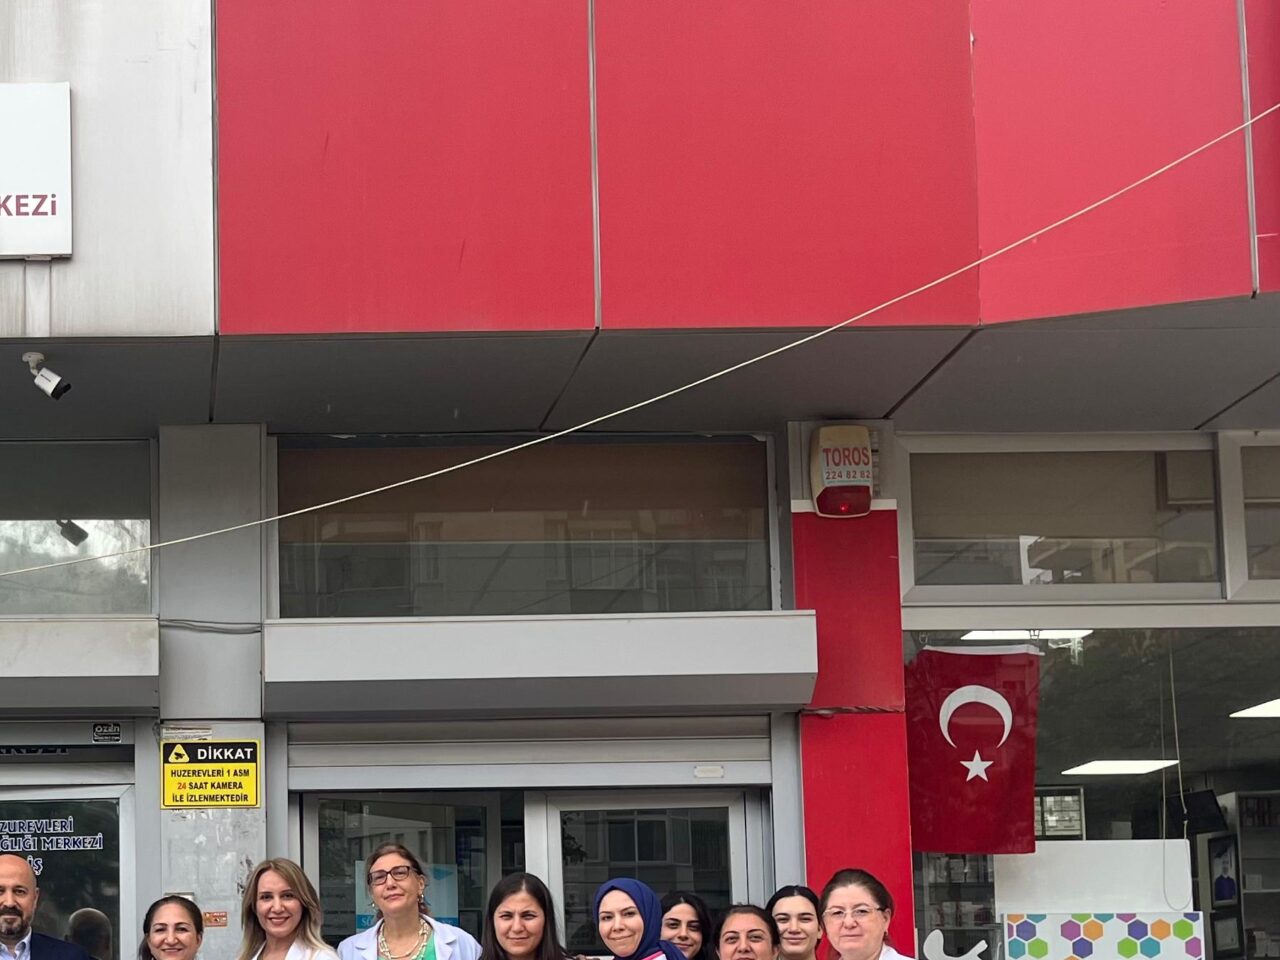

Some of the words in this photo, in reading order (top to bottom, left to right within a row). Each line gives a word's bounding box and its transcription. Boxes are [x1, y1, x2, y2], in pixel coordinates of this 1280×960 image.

[822, 447, 870, 467] TOROS
[825, 470, 843, 480] 224
[197, 745, 254, 760] DİKKAT
[170, 768, 224, 777] HUZEREVLERİ
[226, 769, 231, 777] 1
[232, 769, 250, 777] ASM
[177, 782, 187, 790] 24
[188, 782, 208, 790] SAAT
[210, 782, 243, 790] KAMERA
[172, 793, 184, 802] İLE
[186, 793, 249, 802] İZLENMEKTEDİR
[41, 832, 104, 850] MERKEZİ
